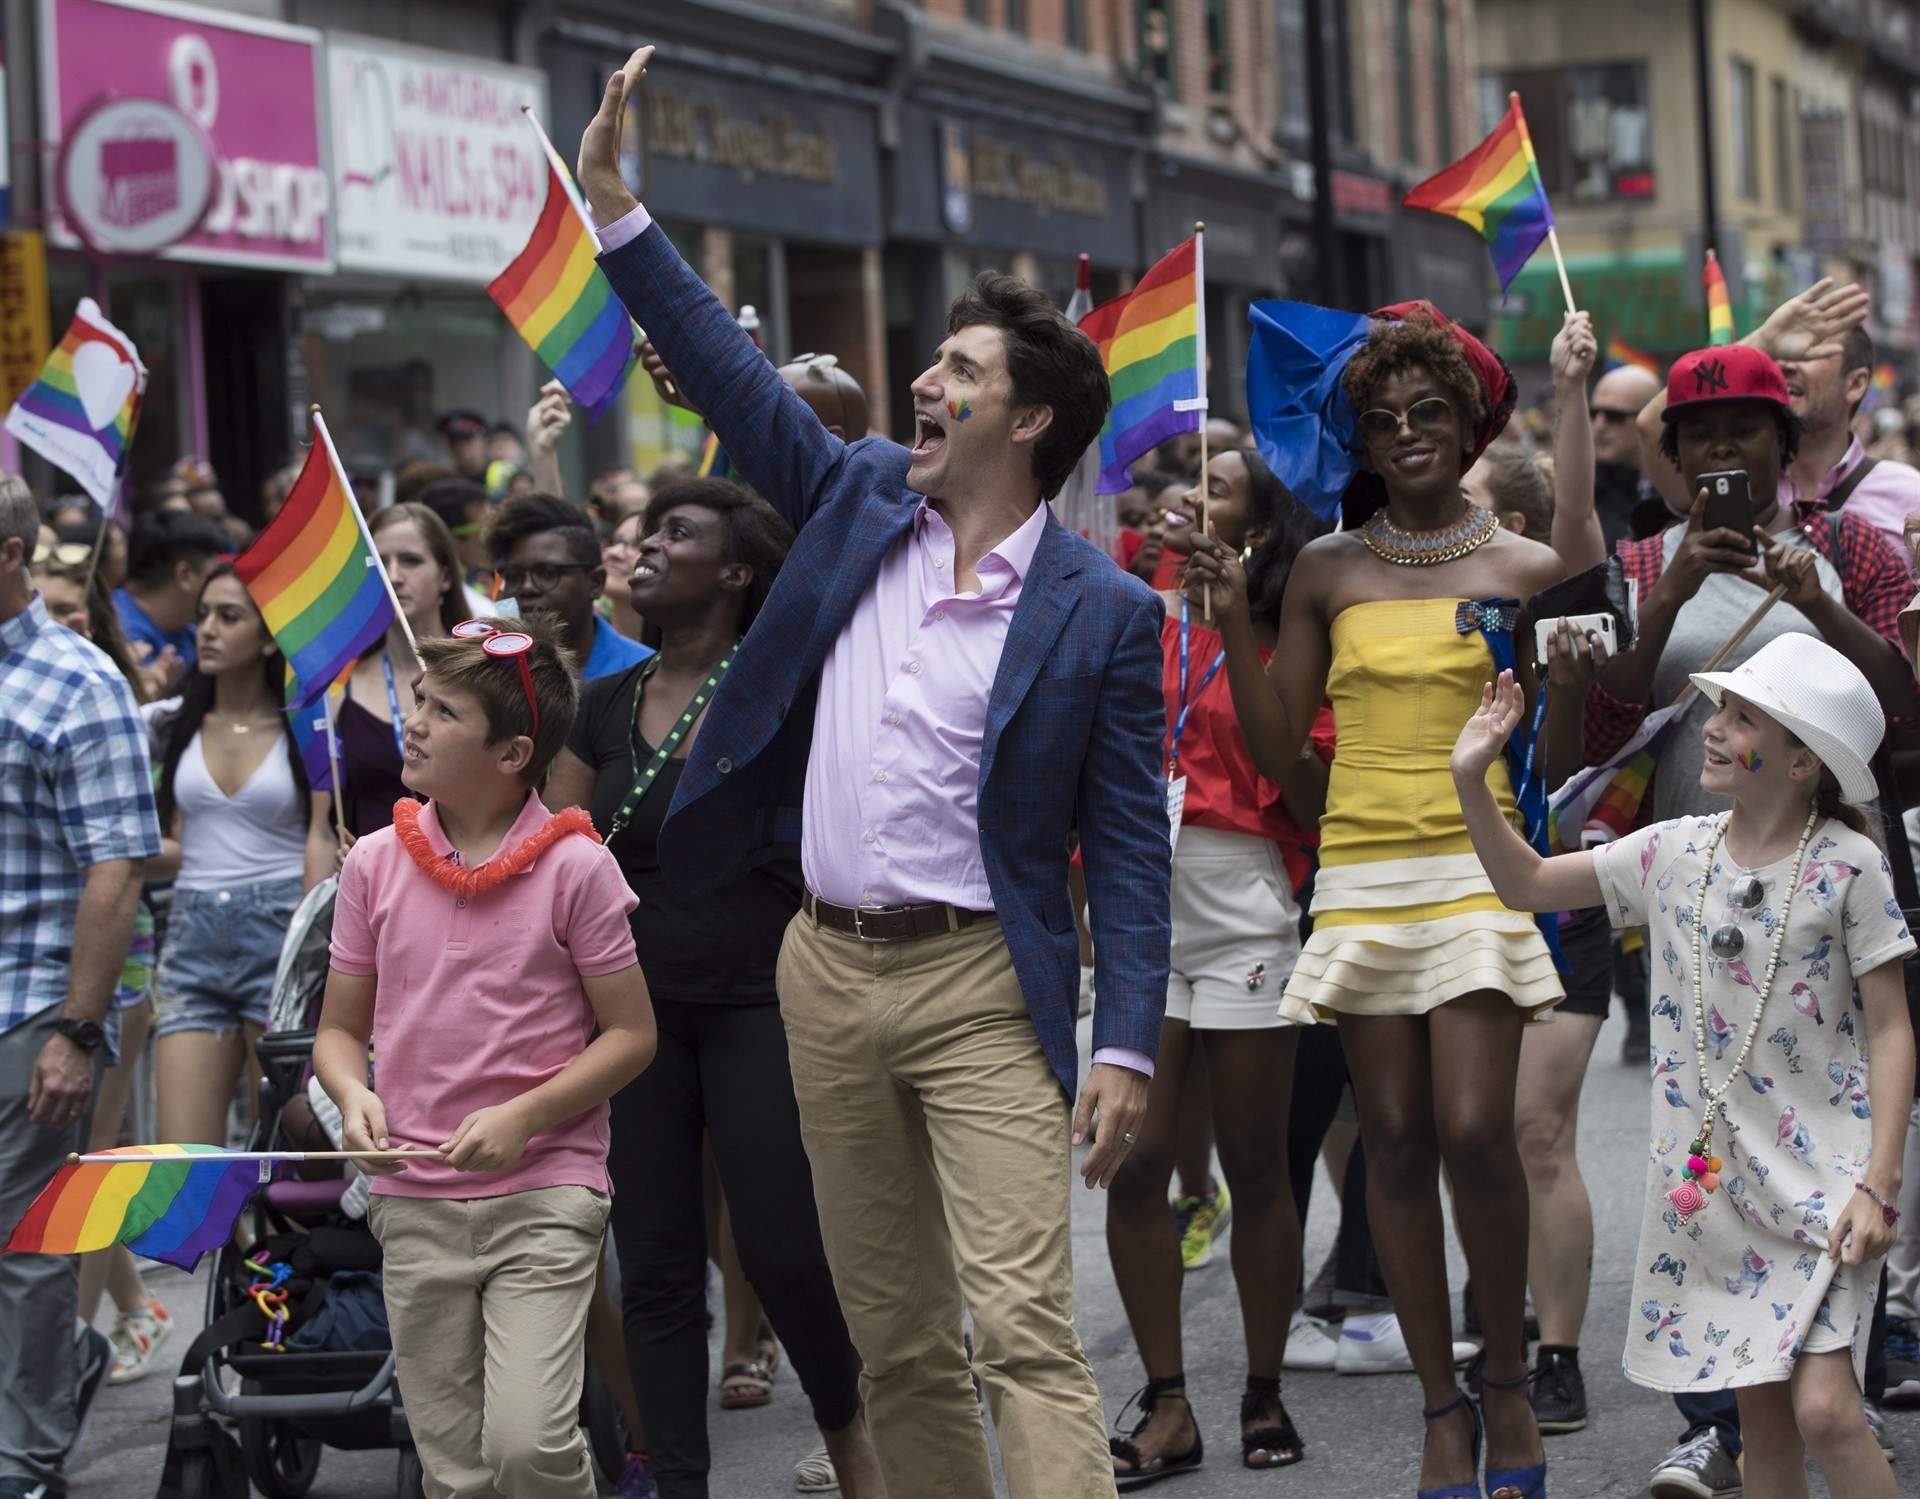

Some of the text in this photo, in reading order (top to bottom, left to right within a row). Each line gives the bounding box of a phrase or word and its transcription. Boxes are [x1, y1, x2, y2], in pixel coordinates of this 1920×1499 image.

[393, 127, 472, 217] NAILS
[492, 141, 537, 223] SPA
[645, 90, 837, 183] RBC Royal Bank
[236, 157, 330, 244] SHOP
[1692, 358, 1729, 394] NY
